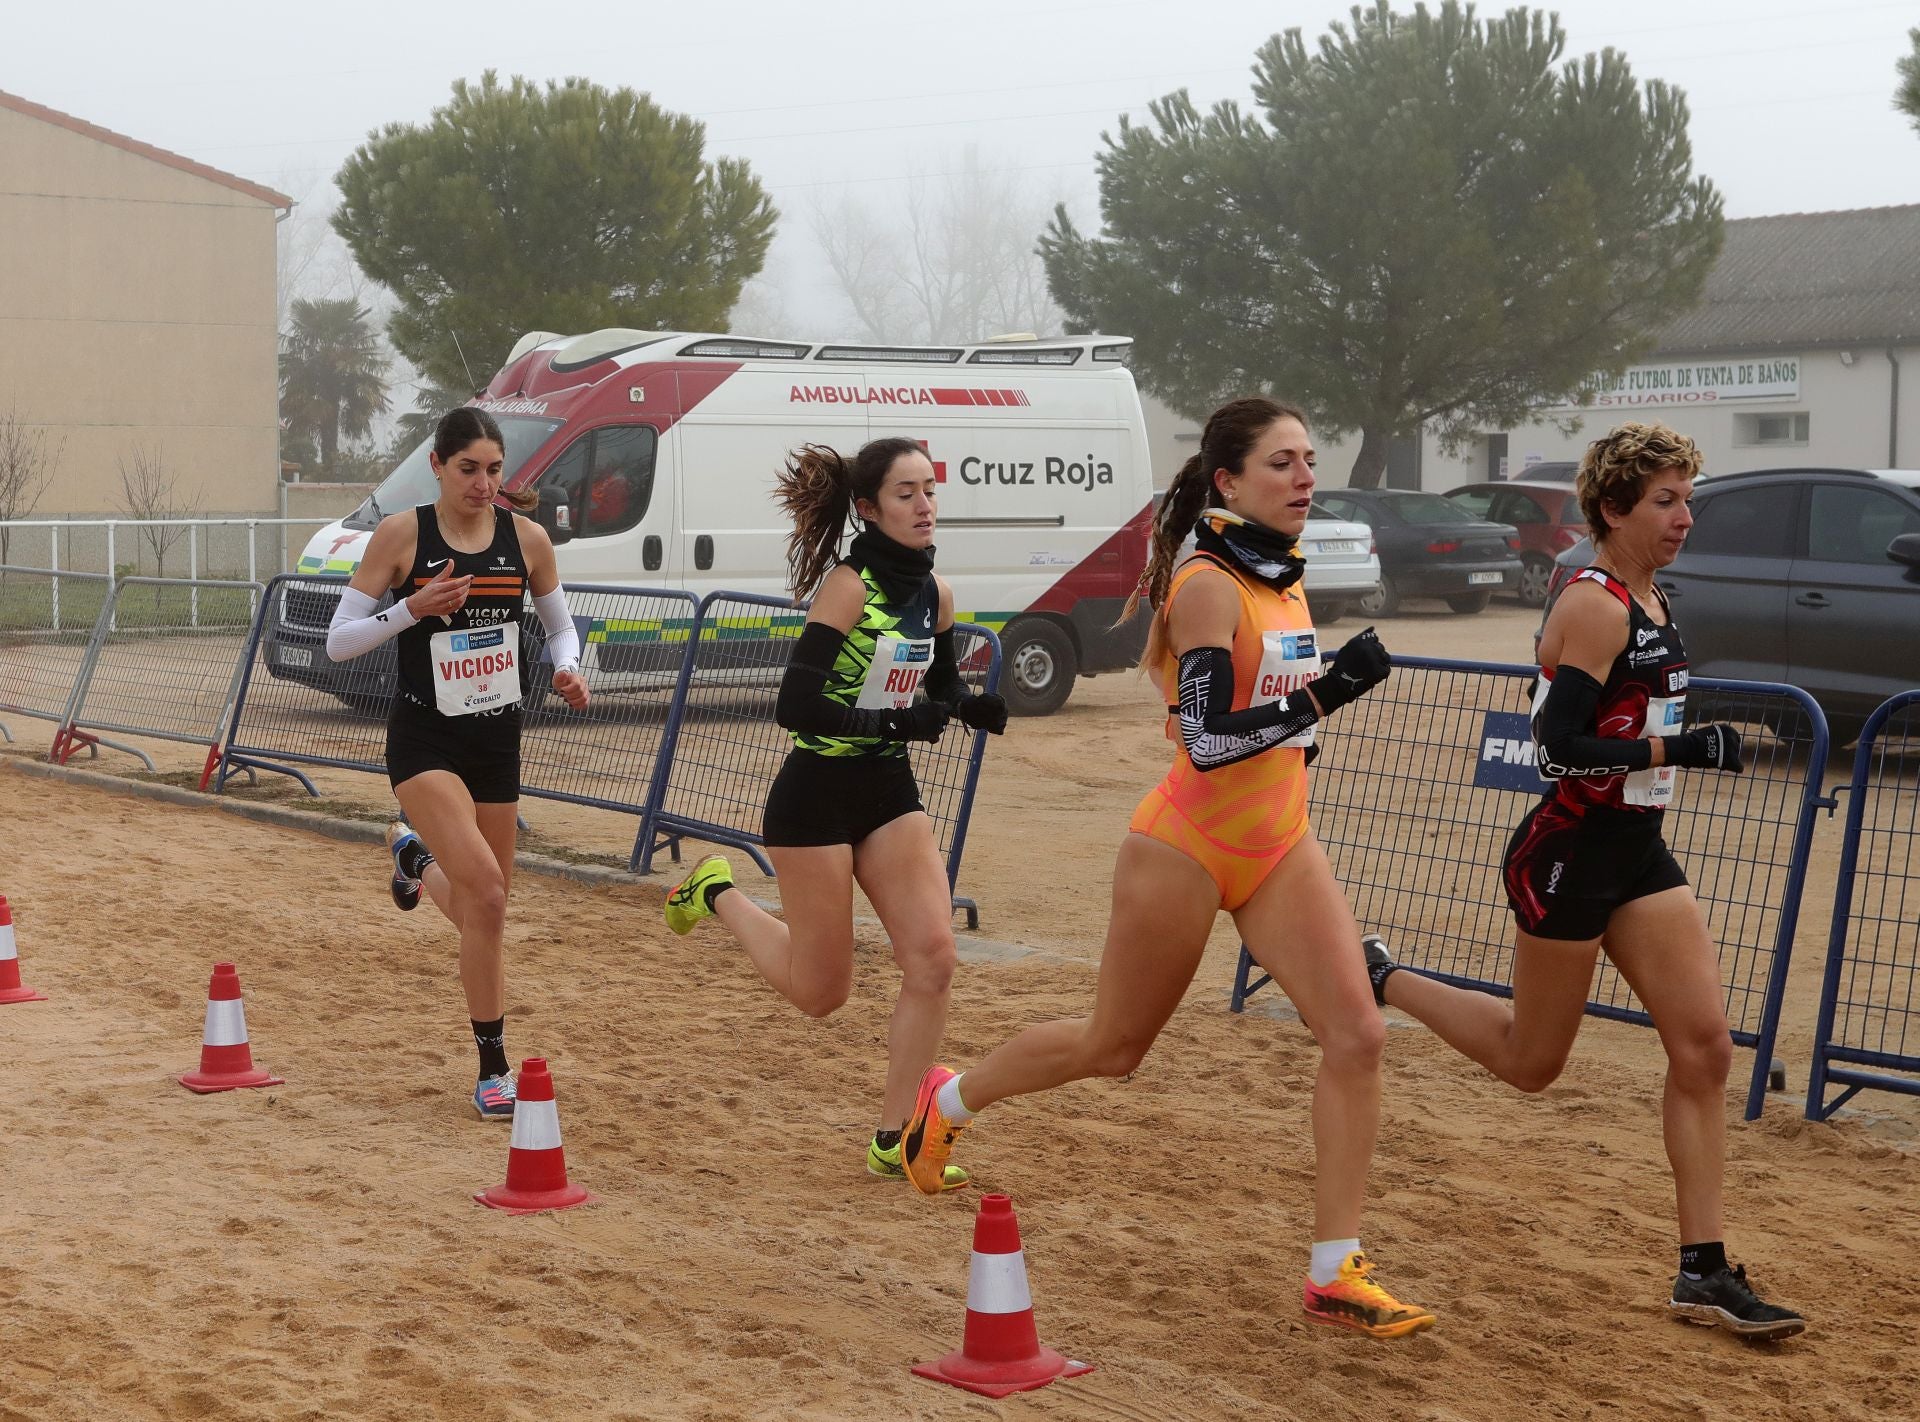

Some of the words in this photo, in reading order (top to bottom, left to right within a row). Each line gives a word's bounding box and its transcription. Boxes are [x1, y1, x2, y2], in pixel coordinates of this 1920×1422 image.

[1628, 368, 1673, 391] FUTBOL
[1677, 368, 1692, 388] DE
[1696, 365, 1734, 387] VENTA
[1738, 364, 1754, 385] DE
[1758, 360, 1797, 384] BAÑOS
[789, 385, 934, 405] AMBULANCIA
[959, 455, 1035, 486] Cruz
[1045, 453, 1114, 491] Roja
[464, 608, 510, 618] VICKY
[469, 632, 498, 641] Diputación
[439, 651, 514, 681] VICIOSA
[478, 684, 488, 692] 38
[473, 693, 501, 704] CEREALTO
